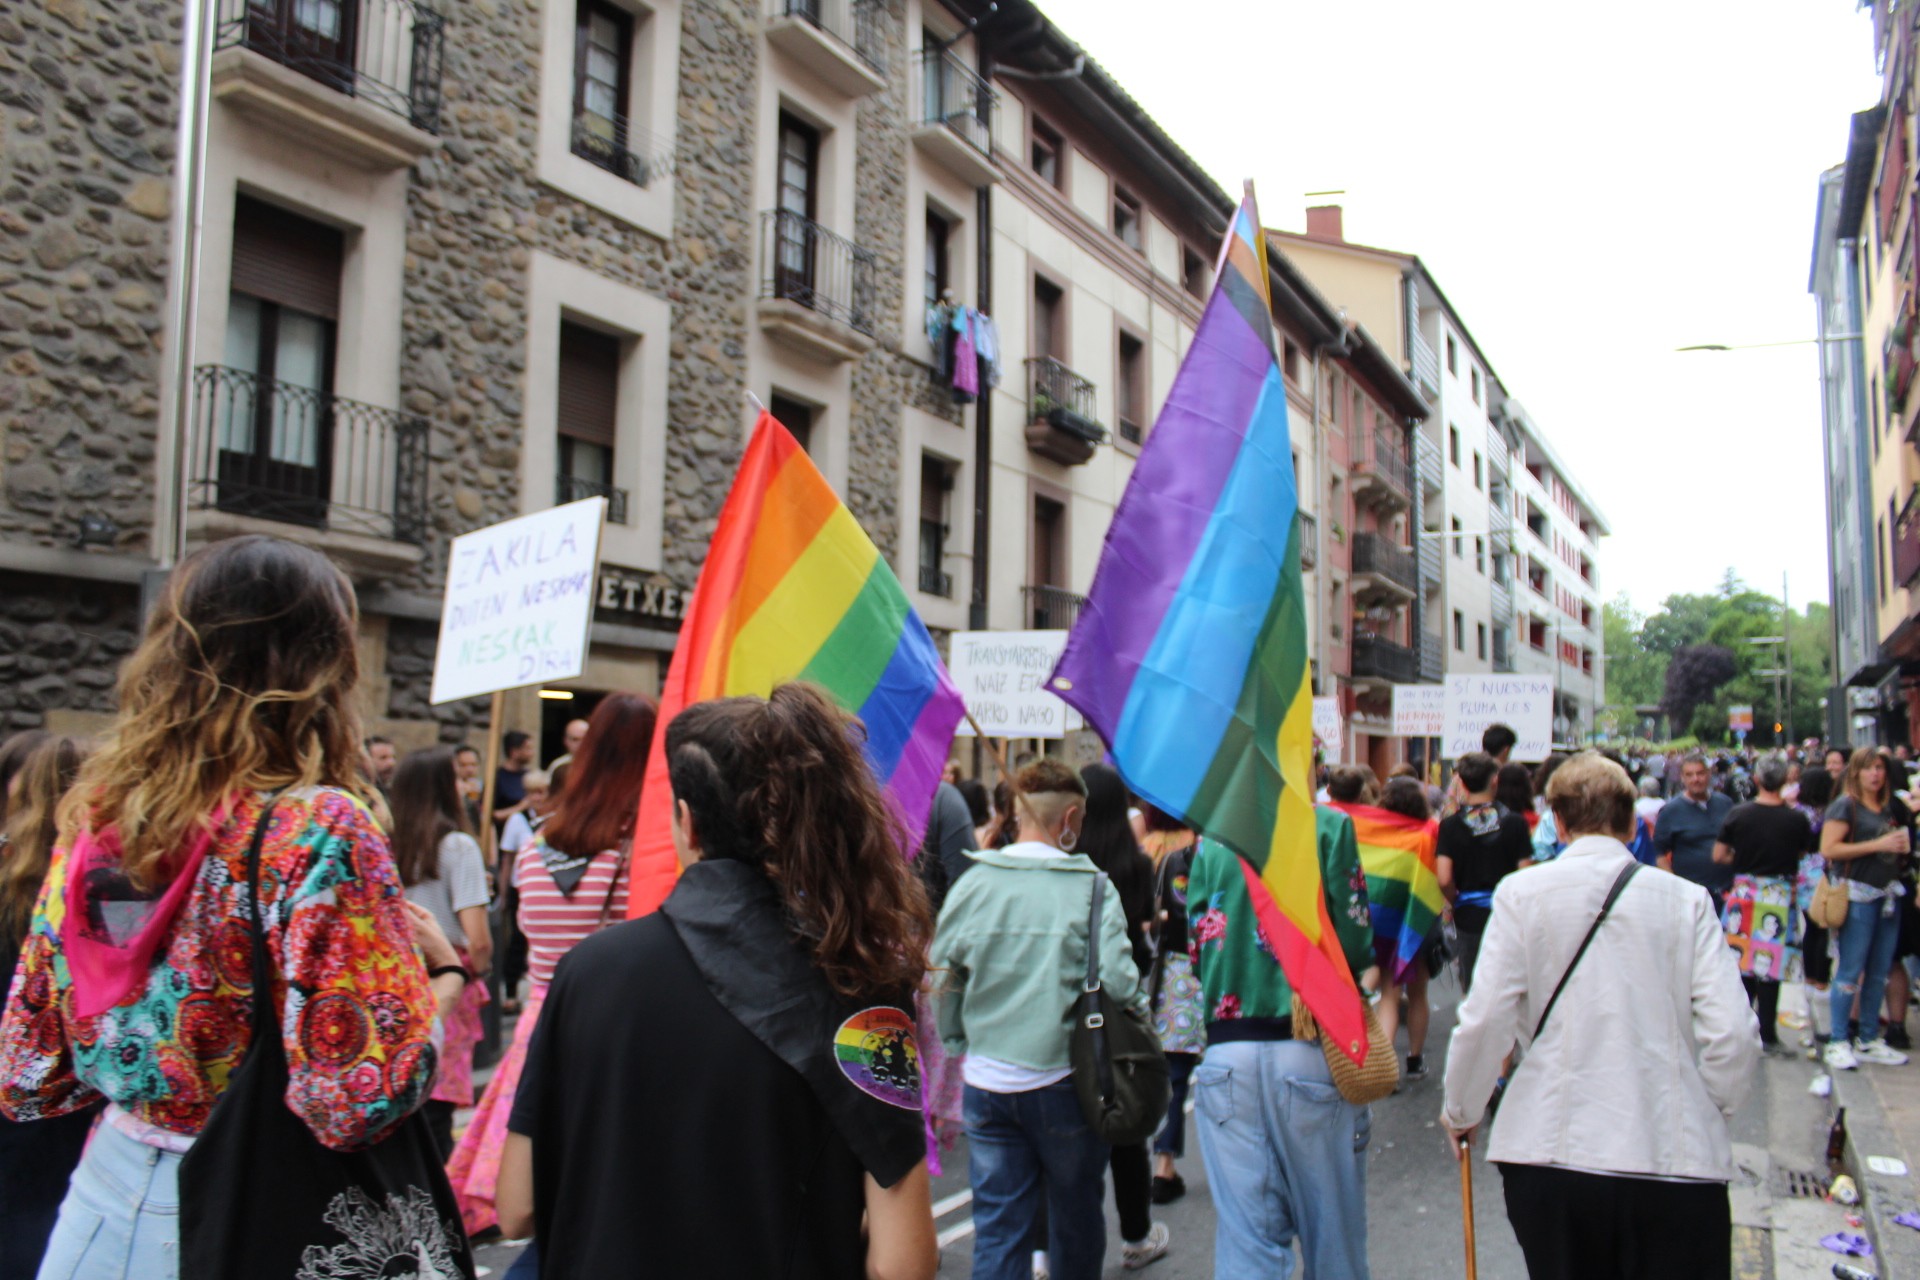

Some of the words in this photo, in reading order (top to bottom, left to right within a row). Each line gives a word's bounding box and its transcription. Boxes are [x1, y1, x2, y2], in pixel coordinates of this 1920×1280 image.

[455, 521, 577, 591] ZAKILA
[448, 591, 509, 632] DUTEN
[457, 620, 557, 668] NESKAK
[1482, 681, 1550, 696] NUESTRA
[1397, 711, 1446, 721] HERMAN
[1460, 701, 1498, 714] PLUMA
